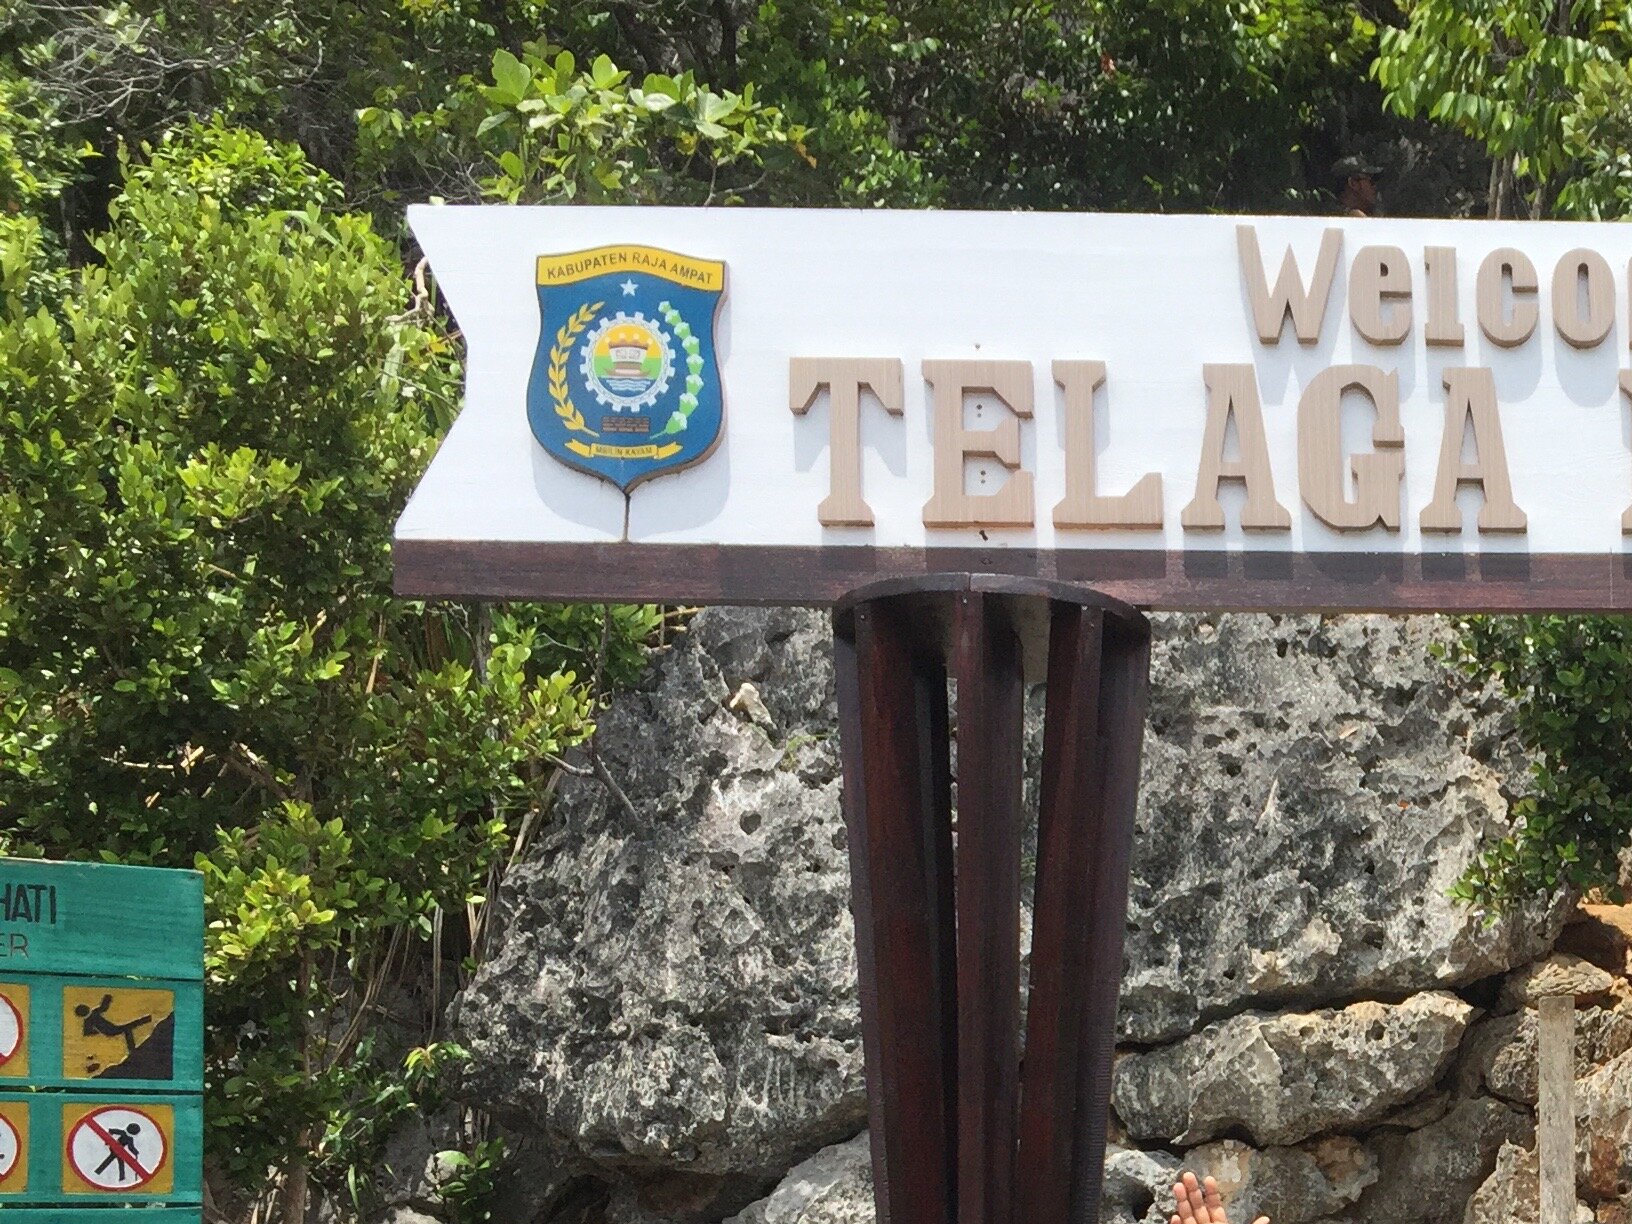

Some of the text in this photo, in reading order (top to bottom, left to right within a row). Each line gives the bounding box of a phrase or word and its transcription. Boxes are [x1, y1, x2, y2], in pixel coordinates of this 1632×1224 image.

[547, 251, 713, 284] KABUPATEN RAJA AMPAT
[789, 356, 1528, 533] TELAGA
